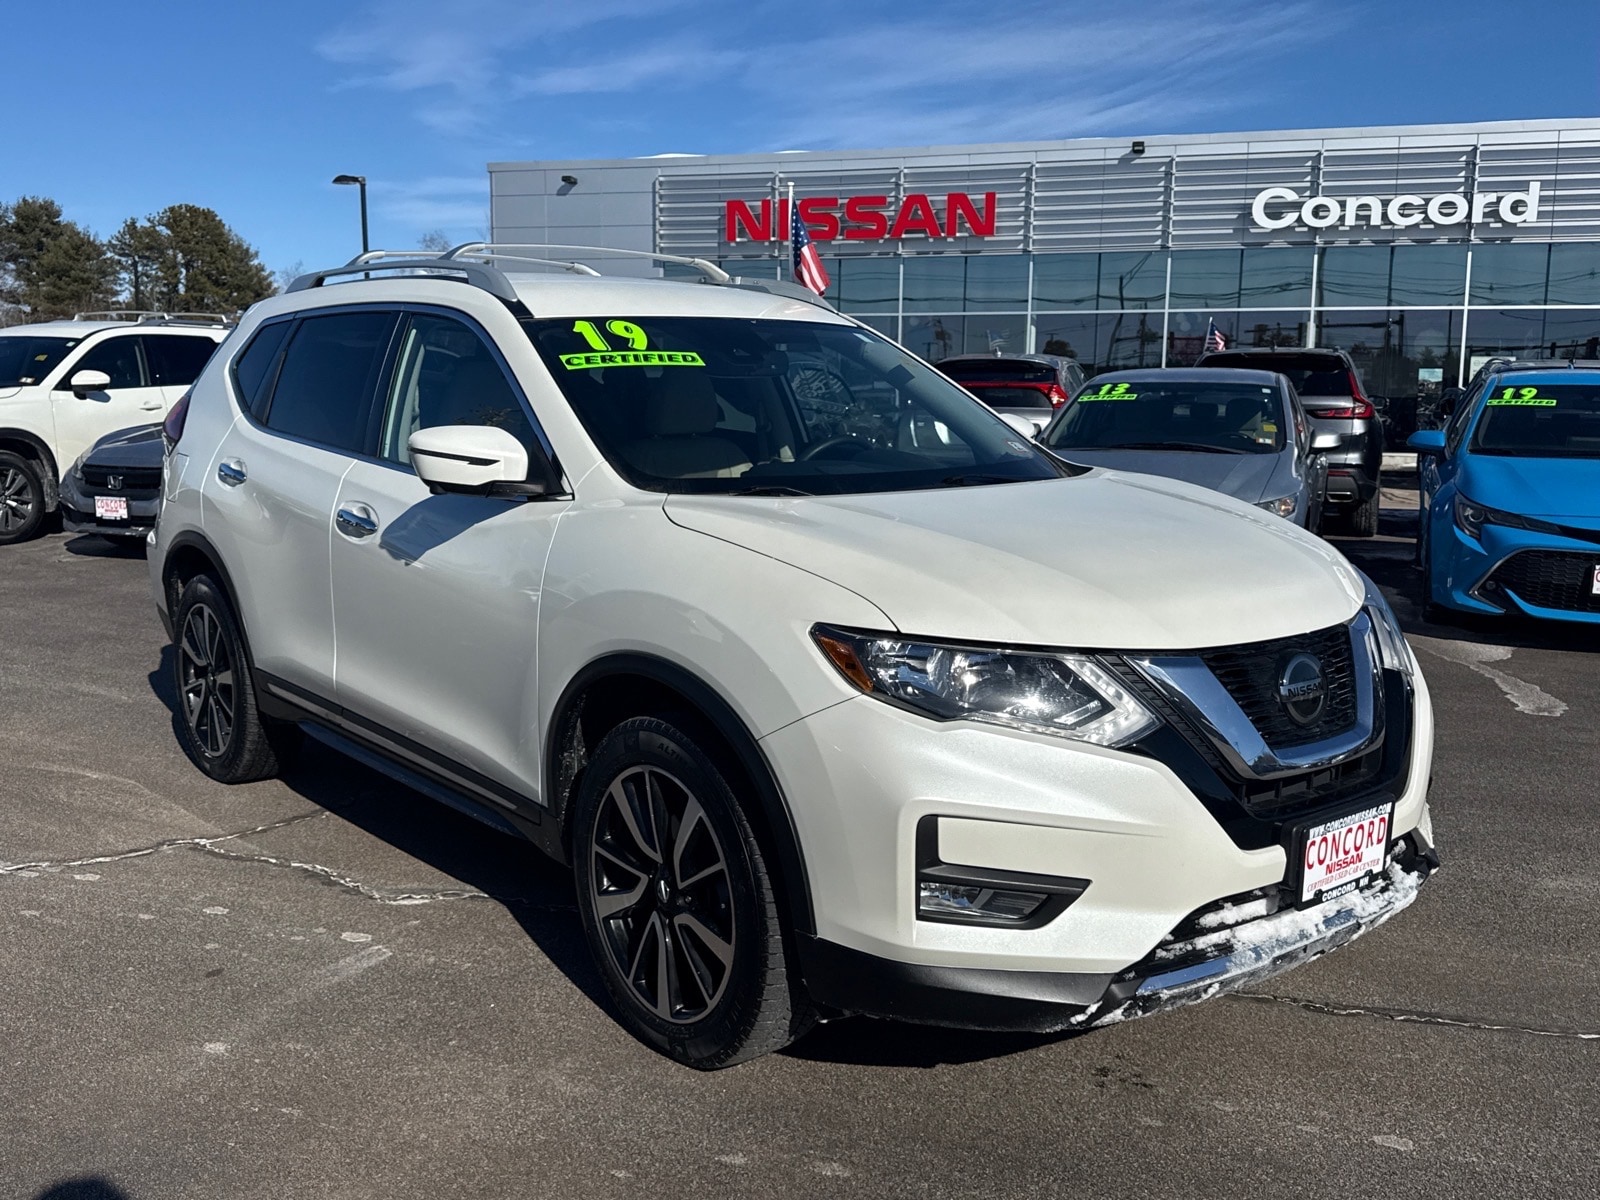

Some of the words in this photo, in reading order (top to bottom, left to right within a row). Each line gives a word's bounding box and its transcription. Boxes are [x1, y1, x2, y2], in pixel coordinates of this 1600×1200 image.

[726, 192, 997, 241] NISSAN
[1252, 181, 1541, 229] Concord
[572, 320, 649, 351] 19
[563, 353, 700, 367] CERTIFIED
[1099, 383, 1131, 395] 13
[1502, 387, 1538, 400] 19
[97, 499, 127, 509] CONCORD
[1306, 817, 1387, 870] CONCORD
[1307, 875, 1335, 893] CERTIFIED
[1334, 870, 1349, 882] USED
[1349, 865, 1360, 876] CAR
[1360, 857, 1381, 872] CENTER
[1325, 852, 1364, 876] NISSAN
[1322, 881, 1357, 902] CONCORD
[1359, 876, 1370, 887] NH
